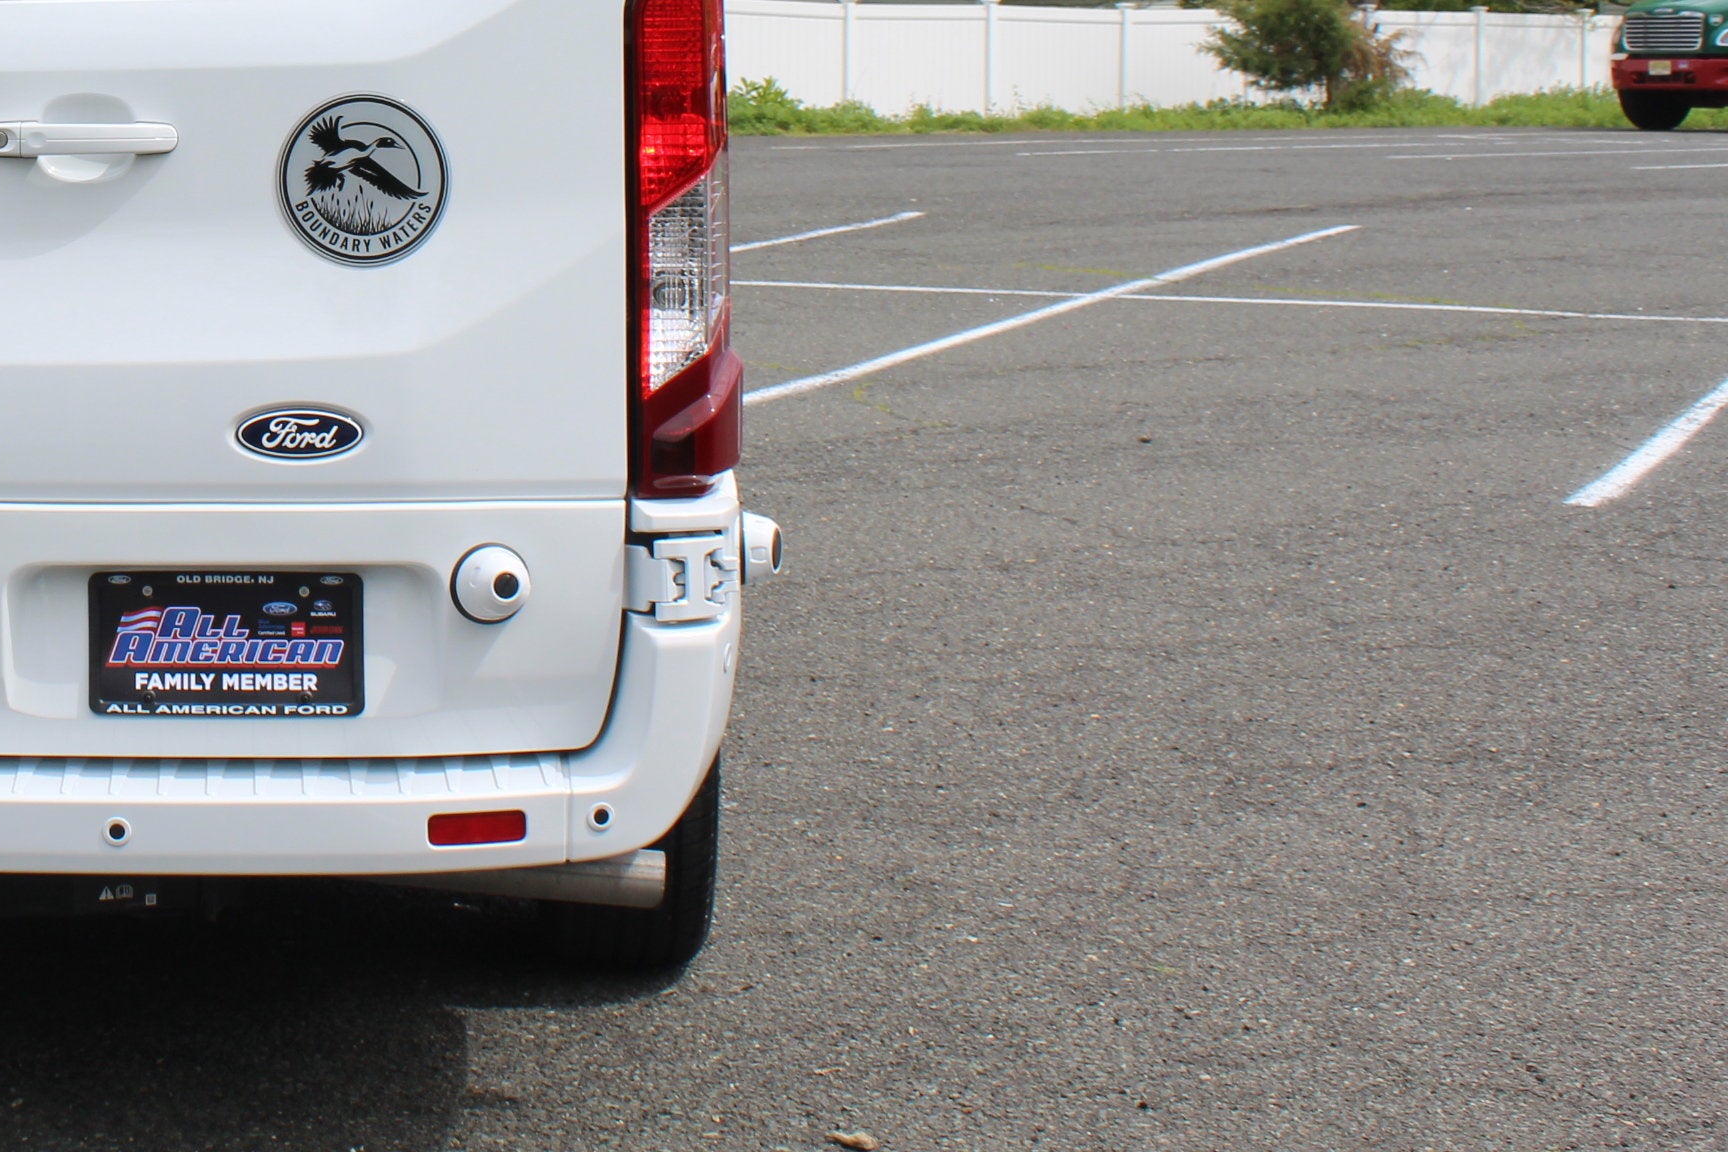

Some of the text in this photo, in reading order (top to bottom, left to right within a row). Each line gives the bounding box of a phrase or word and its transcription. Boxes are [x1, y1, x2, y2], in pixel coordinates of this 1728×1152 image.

[295, 200, 432, 253] BOUNDARY WATERS
[261, 416, 339, 449] Ford
[176, 574, 201, 584] OLD
[258, 575, 274, 584] NJ
[134, 672, 318, 692] FAMILY MEMBER
[106, 703, 348, 715] ALL AMERICAN FORD
